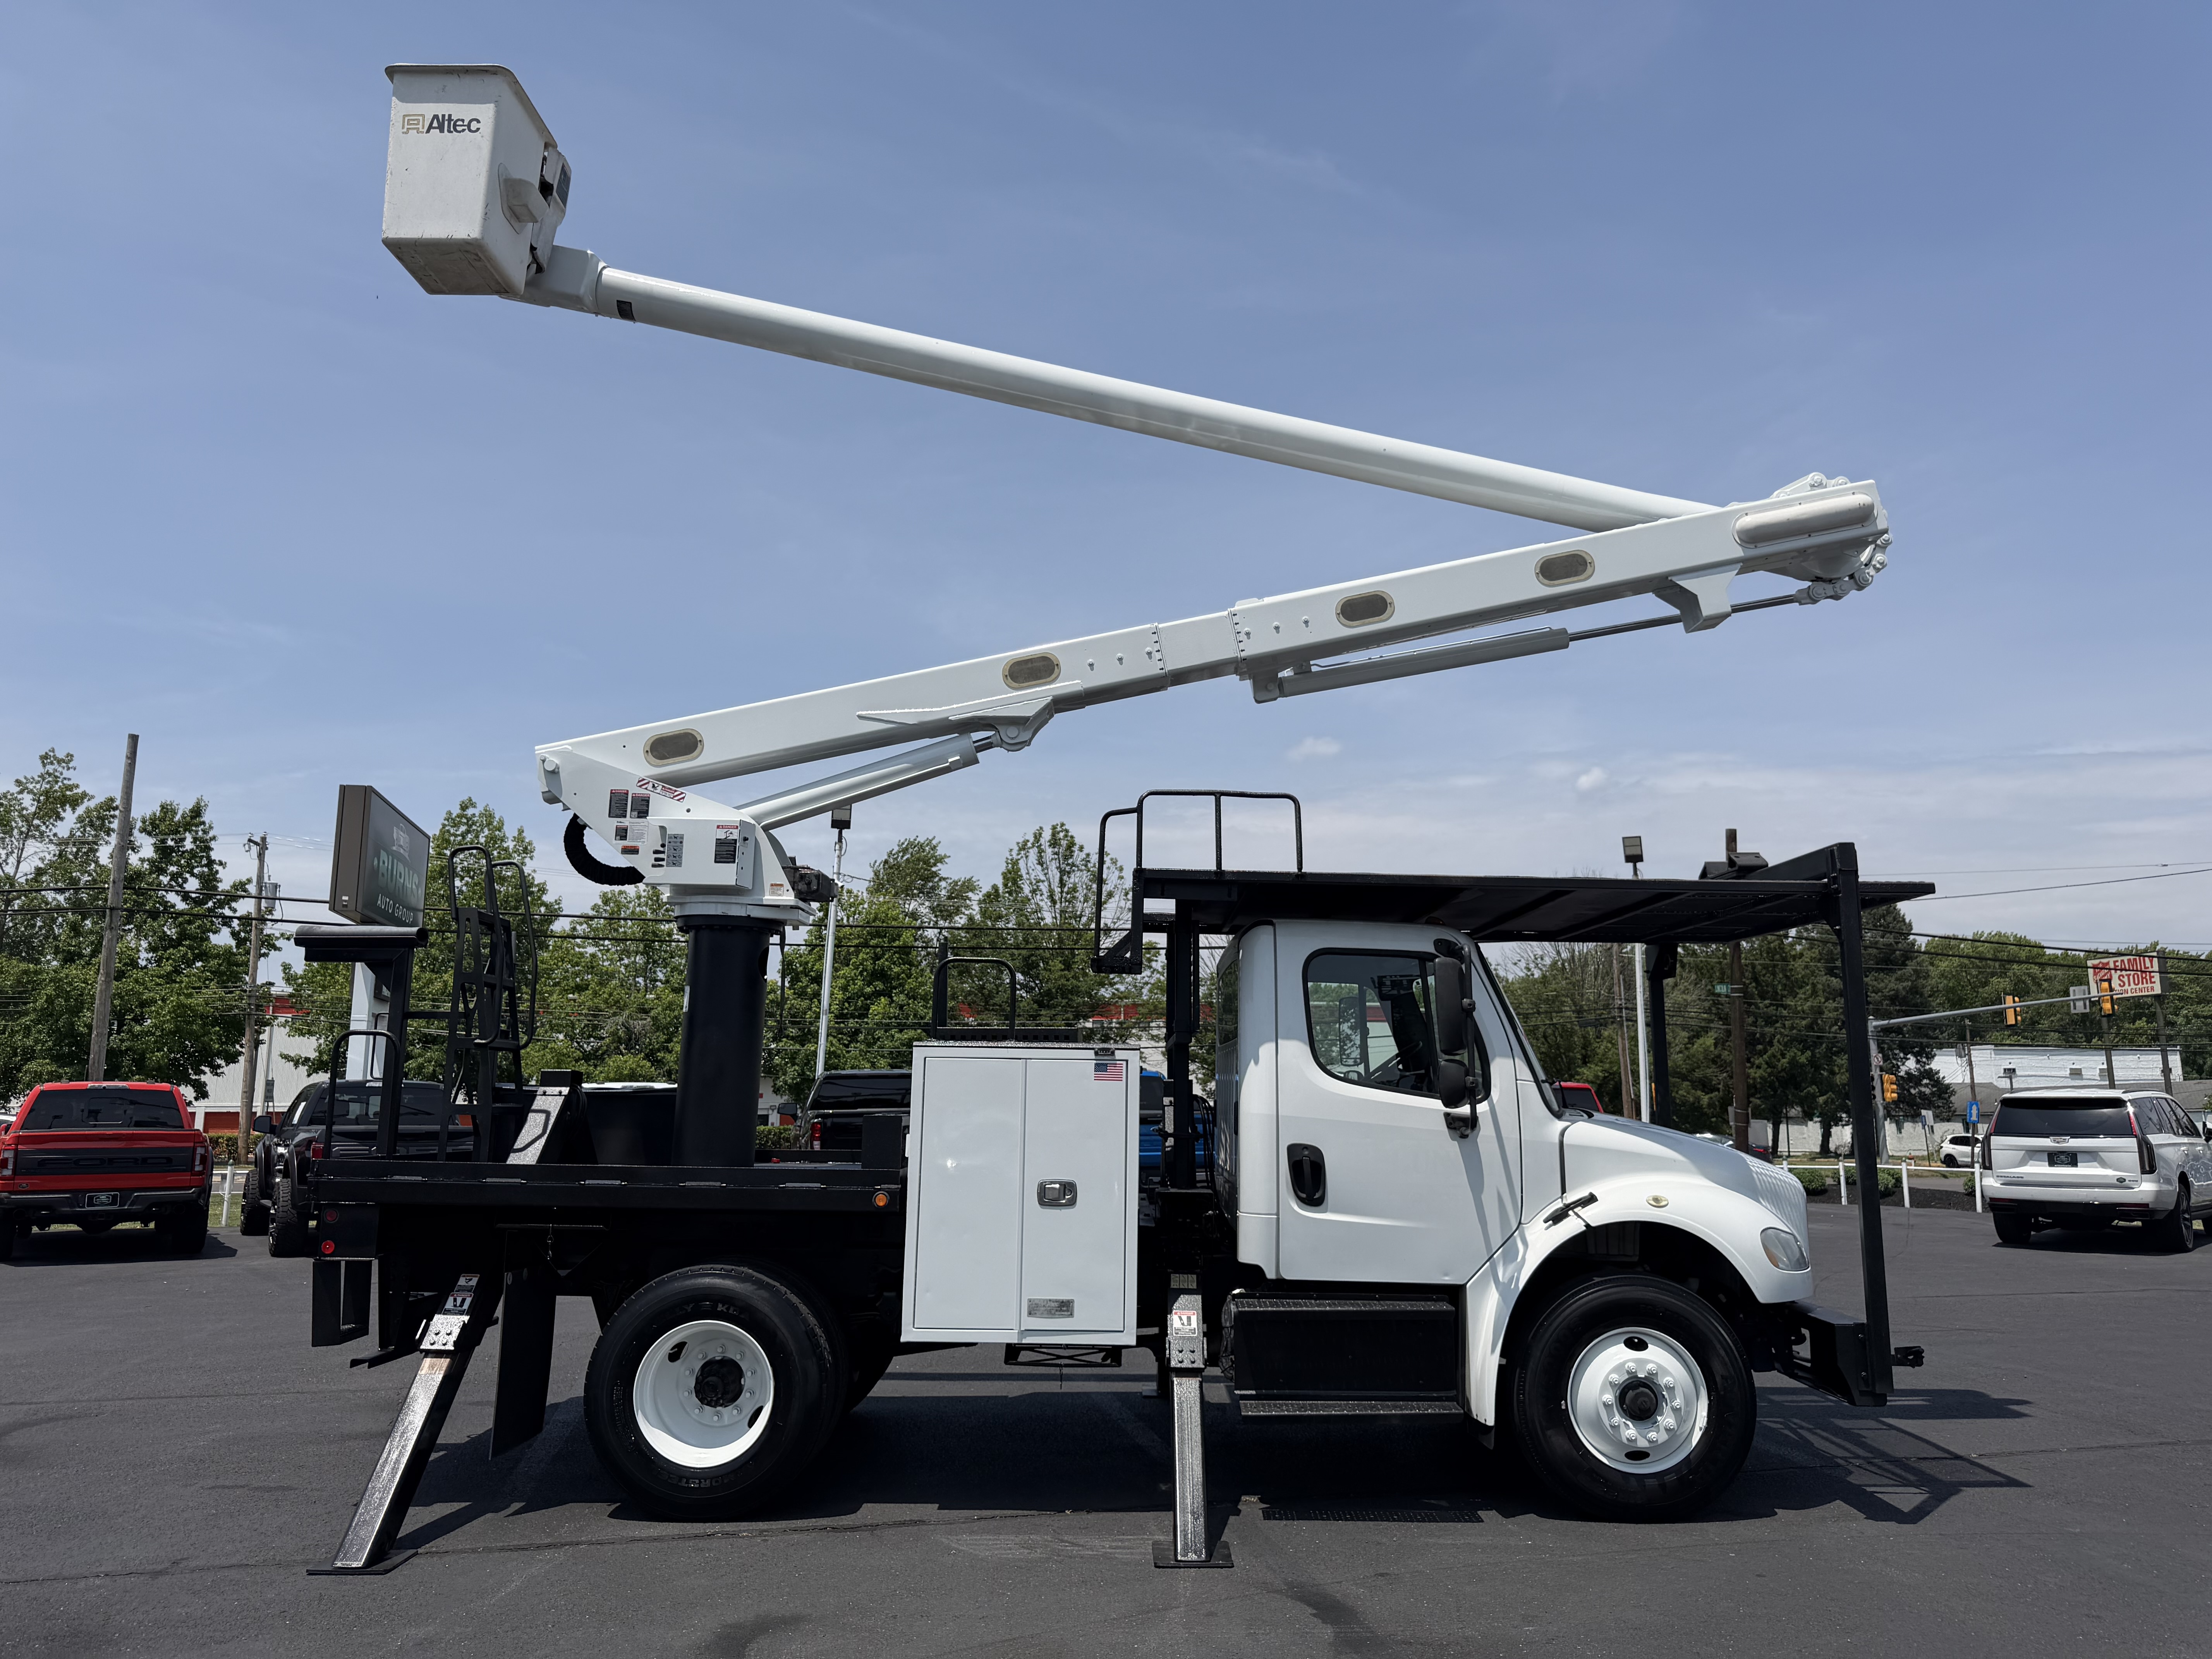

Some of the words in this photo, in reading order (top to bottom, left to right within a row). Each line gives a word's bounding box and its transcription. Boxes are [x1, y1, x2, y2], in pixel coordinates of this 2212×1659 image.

[425, 114, 481, 134] Altec
[378, 849, 419, 906] BURNS
[377, 893, 393, 913] AUTO
[395, 903, 413, 924] GROUP
[2113, 957, 2154, 973] FAMILY
[2118, 972, 2156, 988] STORE
[2130, 986, 2154, 994] CENTER
[38, 1156, 173, 1167] FORD
